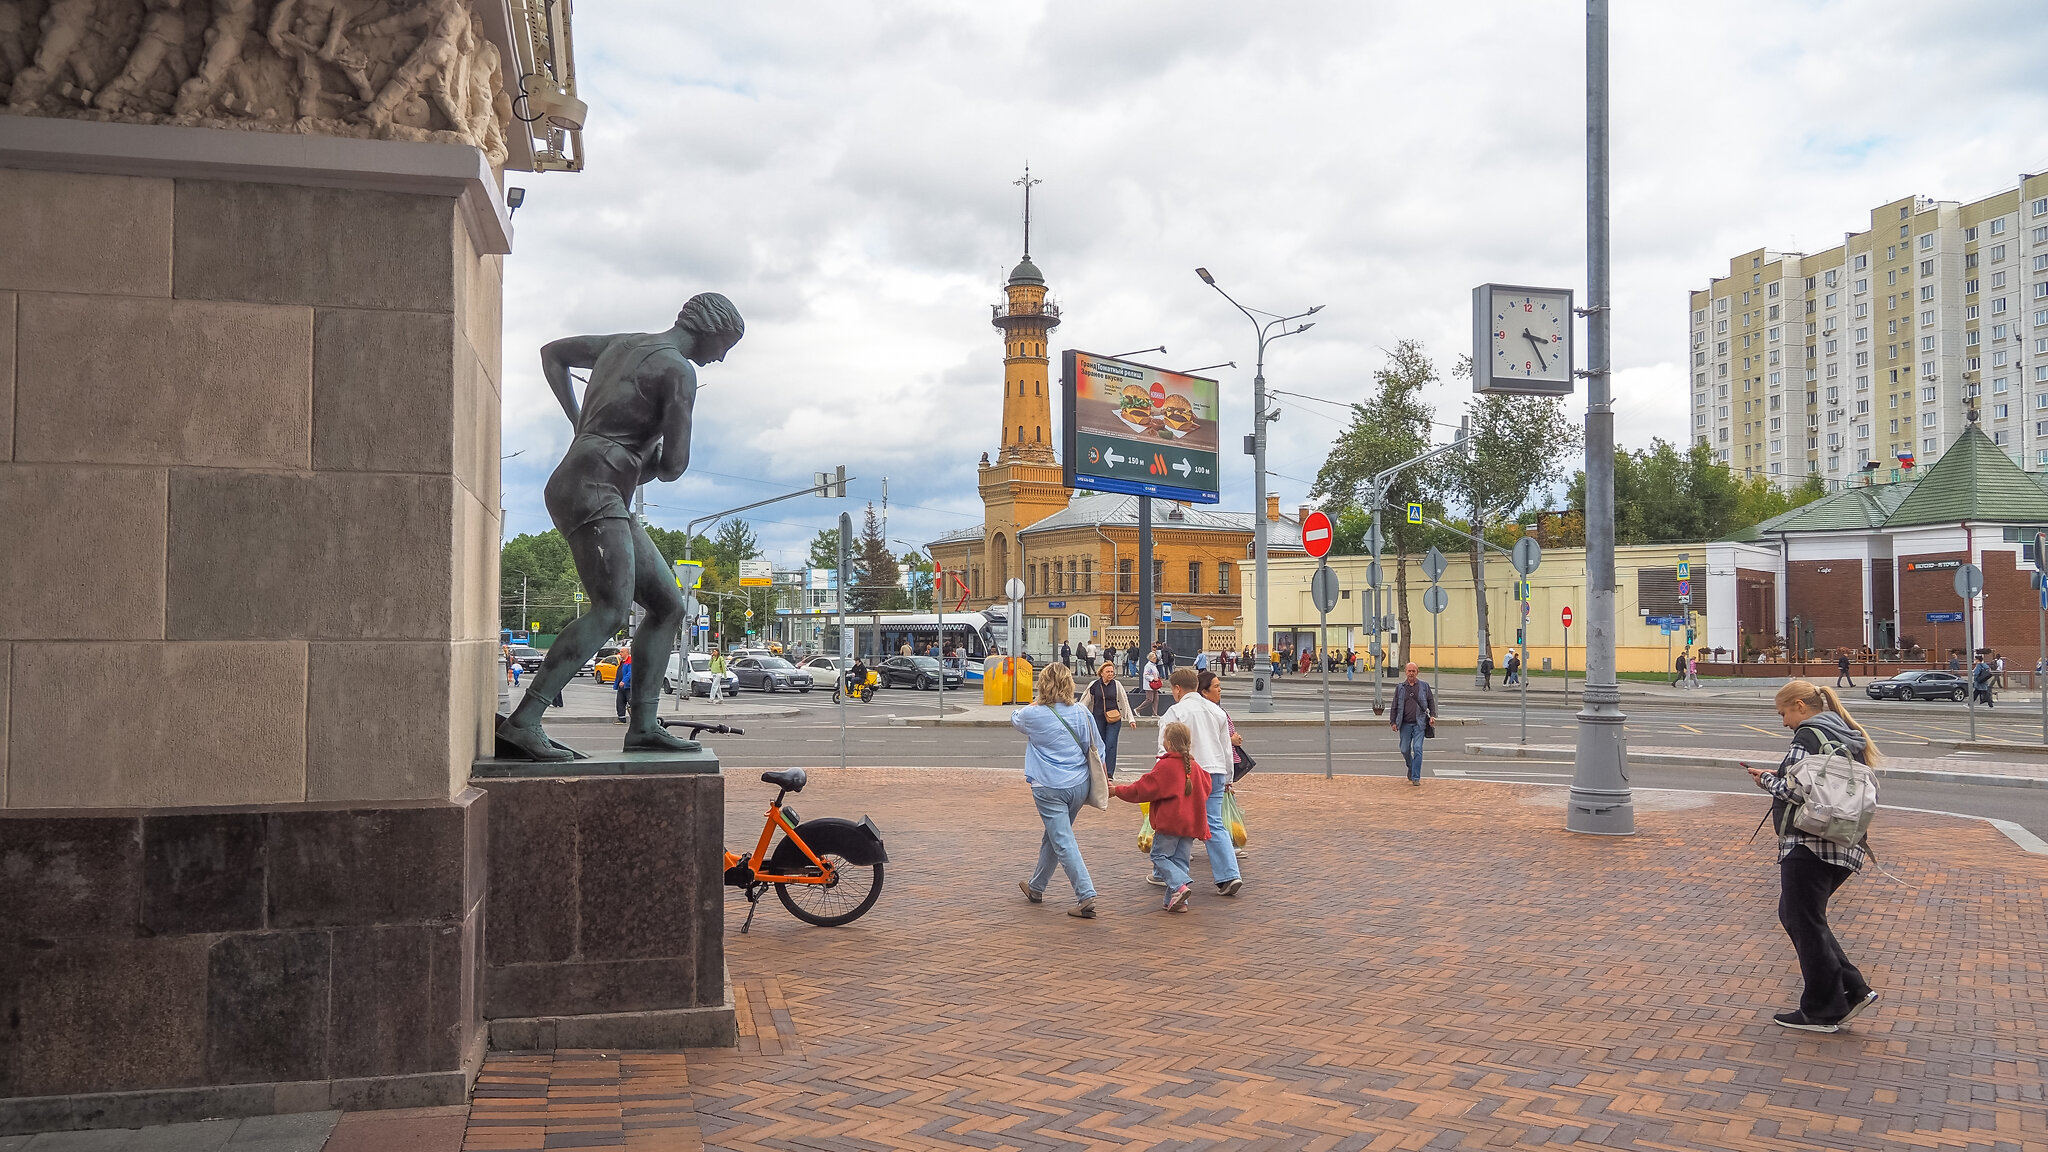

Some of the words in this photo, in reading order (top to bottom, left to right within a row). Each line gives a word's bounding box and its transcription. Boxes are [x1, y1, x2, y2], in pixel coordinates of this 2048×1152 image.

[1523, 303, 1533, 313] 12
[1499, 330, 1505, 339] 9
[1551, 334, 1558, 343] 3
[1080, 360, 1097, 370] Гранд
[1097, 363, 1124, 375] Томатный
[1525, 361, 1532, 370] 6
[1080, 368, 1104, 378] Заранее
[1104, 374, 1123, 382] вкусно
[1127, 456, 1139, 465] 150
[1194, 466, 1205, 474] 100
